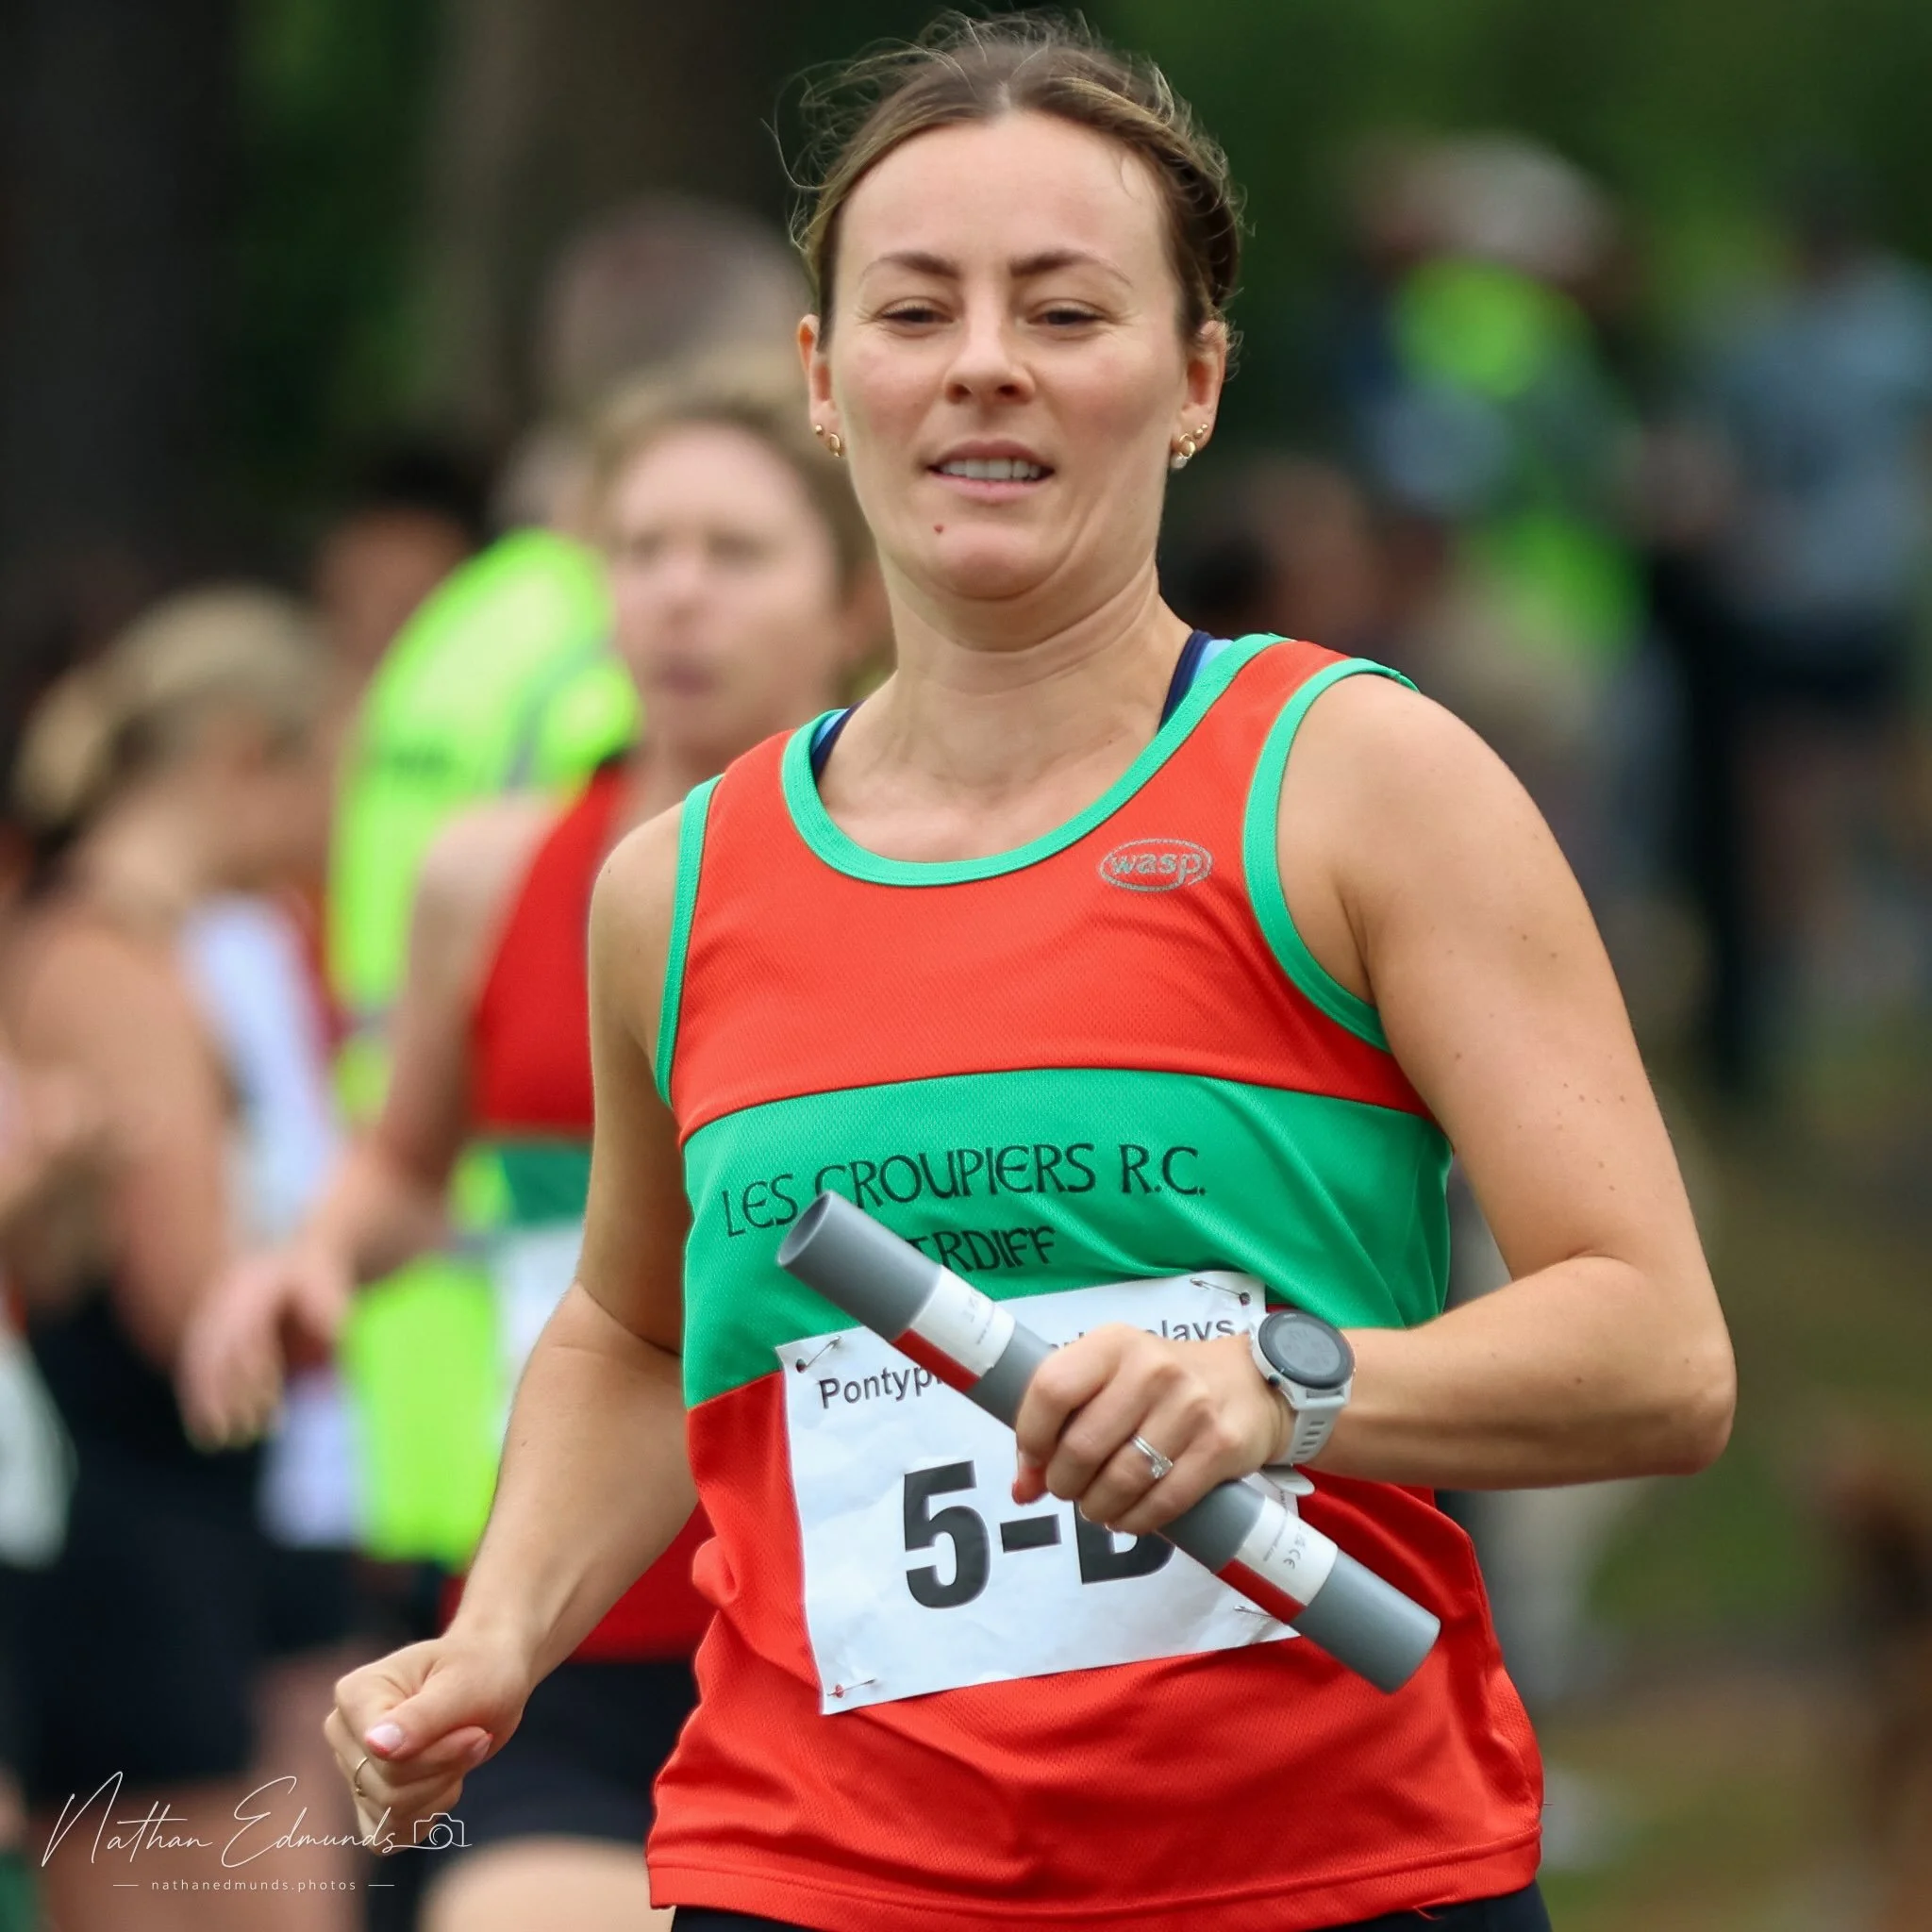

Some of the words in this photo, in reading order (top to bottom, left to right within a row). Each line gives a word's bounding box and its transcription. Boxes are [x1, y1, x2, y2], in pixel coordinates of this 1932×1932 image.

[1110, 853, 1204, 886] wasp
[722, 1174, 798, 1237] LES
[814, 1143, 1096, 1209] CROUPIERS
[1119, 1144, 1207, 1197] R.C.
[905, 1224, 1057, 1273] RDIFF
[818, 1366, 942, 1410] Pontyp
